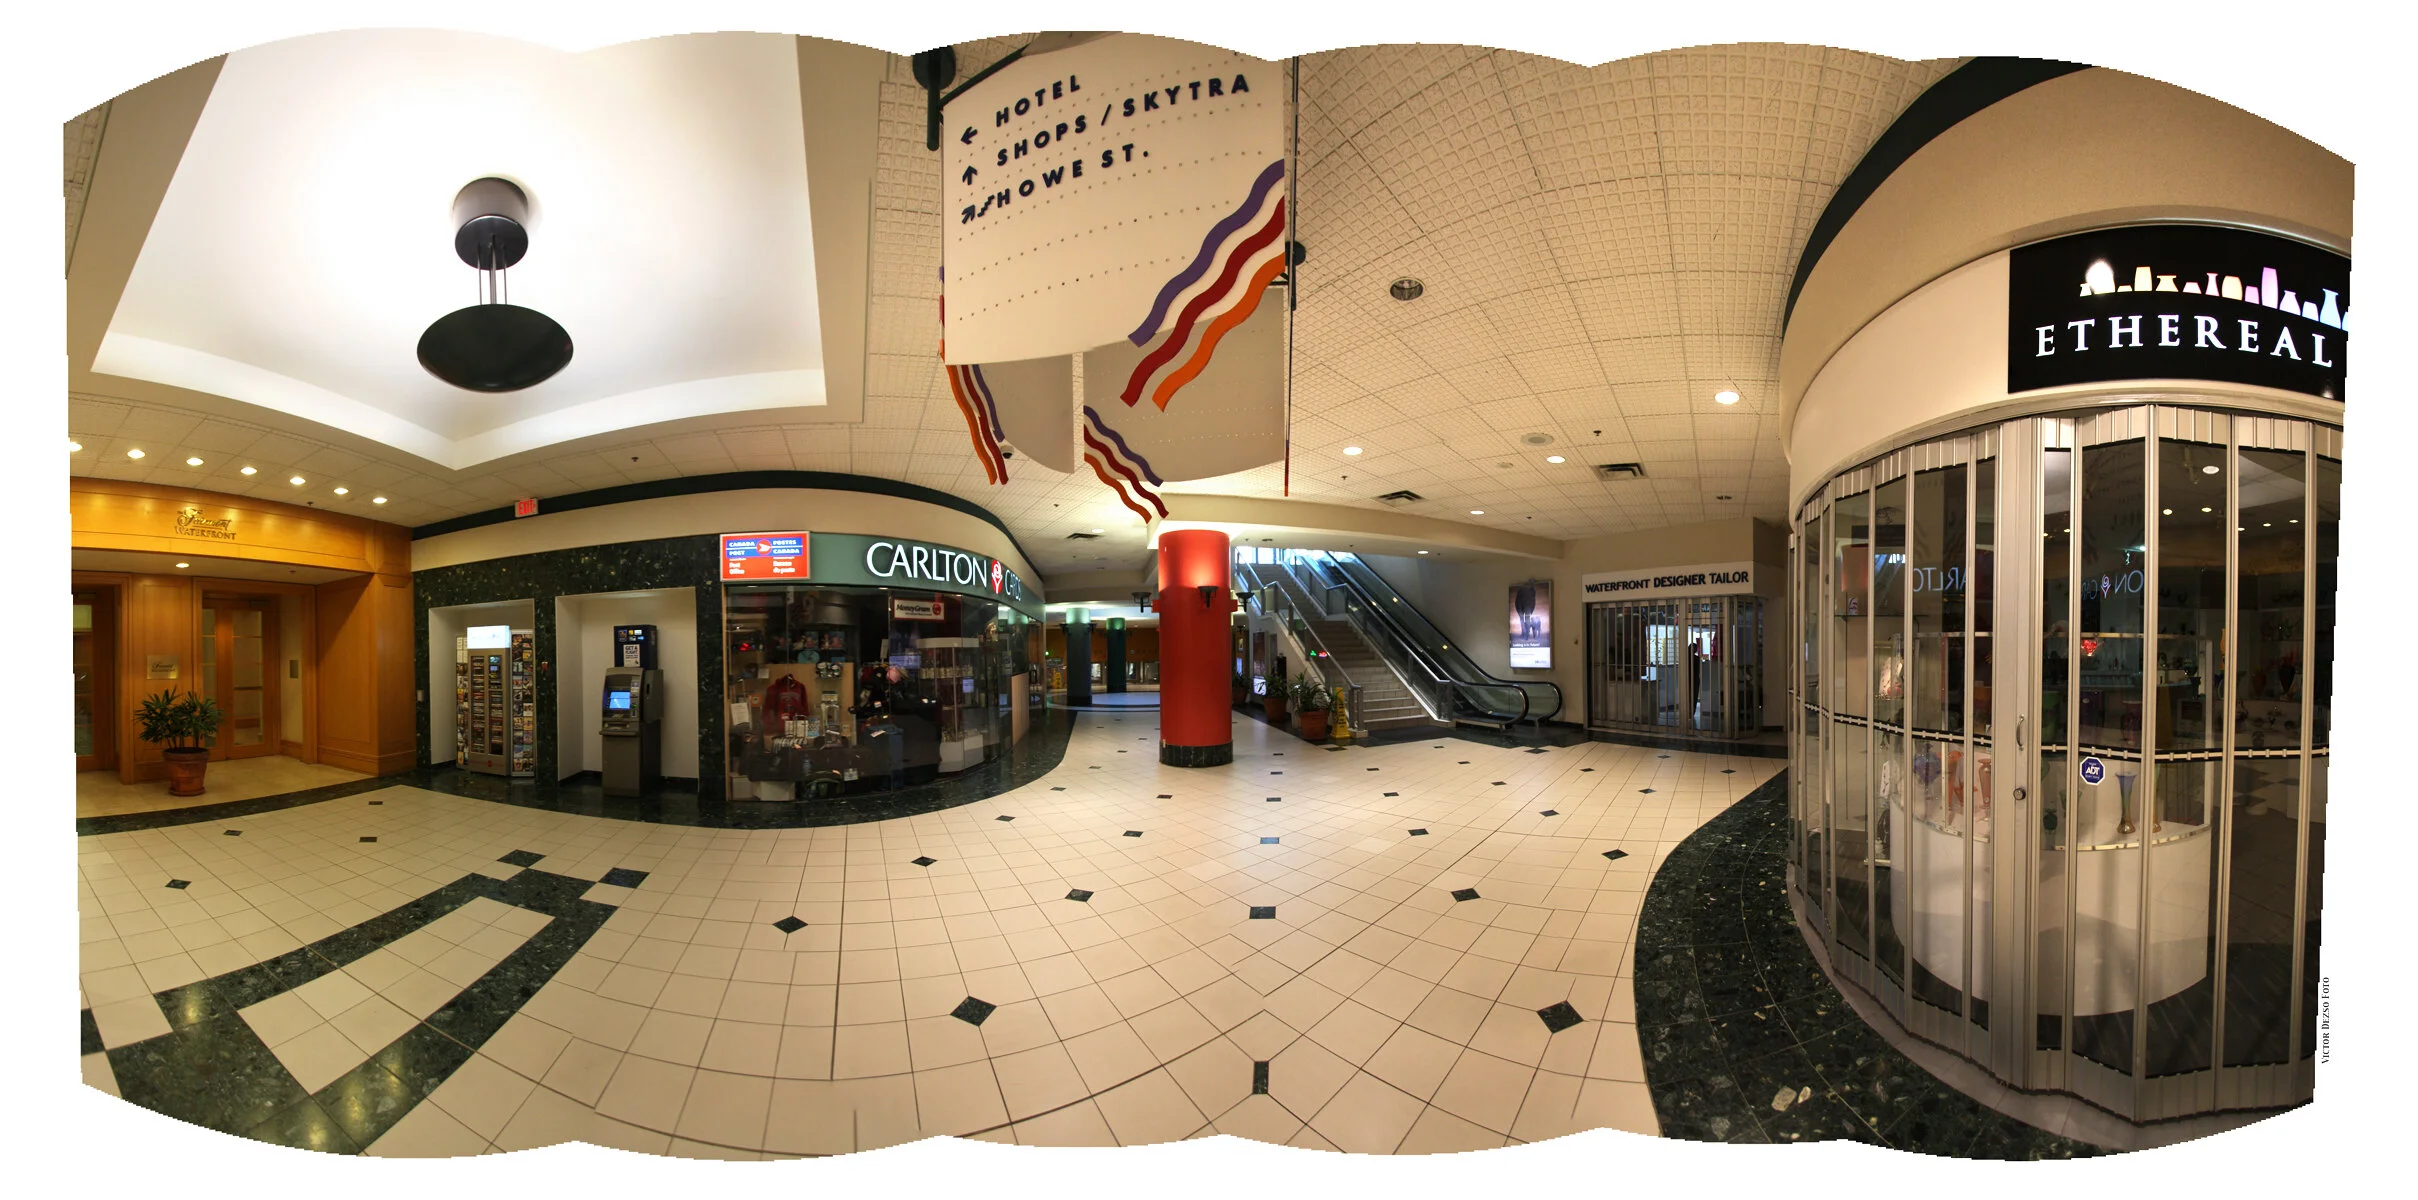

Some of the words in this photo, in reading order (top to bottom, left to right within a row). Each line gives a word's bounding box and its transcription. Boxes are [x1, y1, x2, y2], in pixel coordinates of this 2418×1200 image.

[995, 75, 1081, 128] HOTEL
[997, 114, 1087, 167] SHOPS
[1122, 74, 1250, 117] SKYTRA
[996, 159, 1083, 208] HOWE
[1101, 143, 1149, 169] ST.
[2035, 314, 2333, 368] ETHEREAL
[174, 525, 237, 540] WATERFRONT
[866, 541, 988, 588] CARLTON
[1584, 578, 1651, 594] WATERFRONT
[1653, 573, 1706, 588] DESIGNER
[1708, 571, 1749, 585] TAILOR
[2085, 766, 2100, 775] ADT
